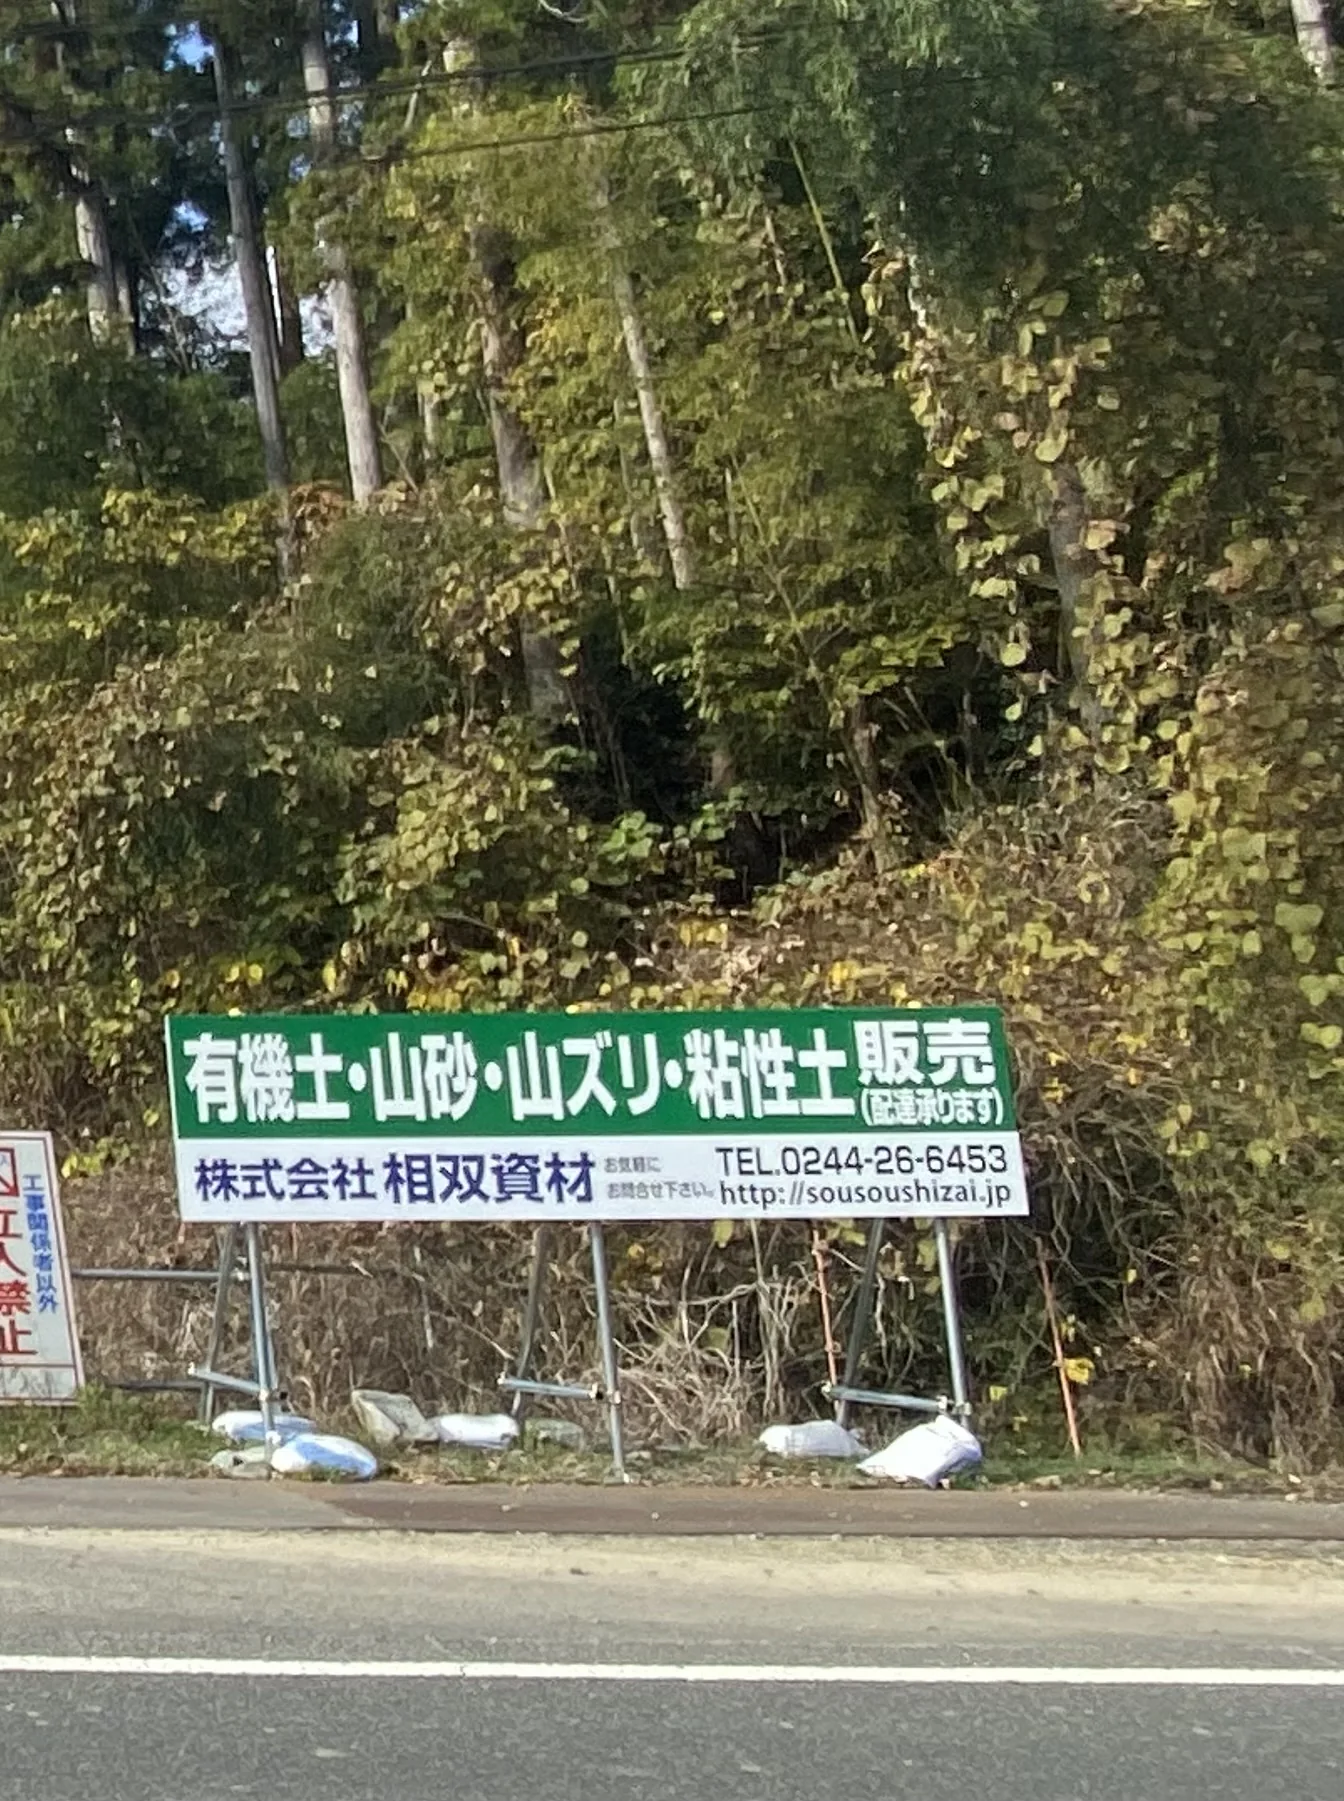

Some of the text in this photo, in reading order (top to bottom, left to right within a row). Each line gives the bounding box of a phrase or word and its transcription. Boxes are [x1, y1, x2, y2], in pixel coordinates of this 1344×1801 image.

[853, 1018, 996, 1086] 販売
[194, 1152, 596, 1205] 株式会社 相双資材
[714, 1145, 1008, 1177] TEL.0244-26-6453
[719, 1179, 1011, 1209] http://sousoushizai.jp
[22, 1173, 59, 1315] 工事関係者以外
